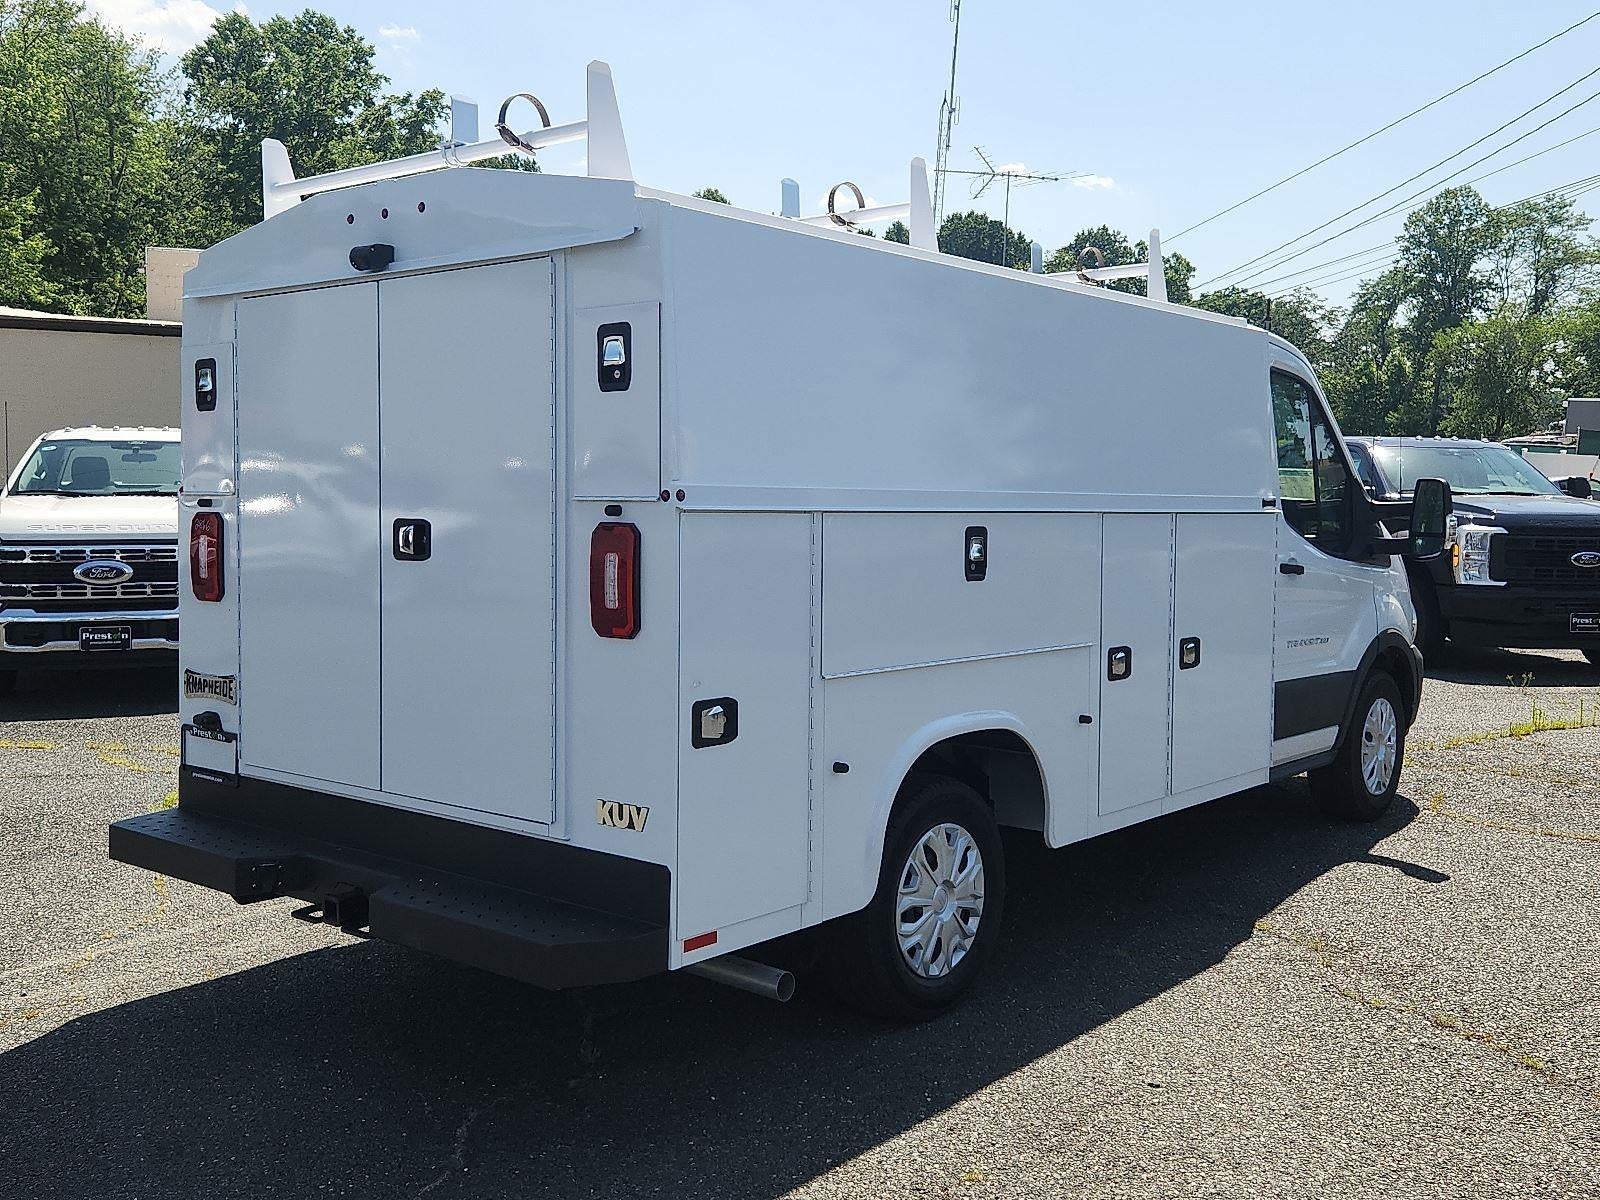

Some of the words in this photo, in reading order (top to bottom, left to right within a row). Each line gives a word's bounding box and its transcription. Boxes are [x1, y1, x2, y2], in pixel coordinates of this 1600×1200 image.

[27, 523, 111, 532] SUPER
[117, 522, 178, 532] DUTY
[1580, 553, 1600, 564] Ford
[89, 567, 117, 579] Ford
[185, 673, 235, 701] KNAPHEIDE
[596, 798, 650, 832] KUV
